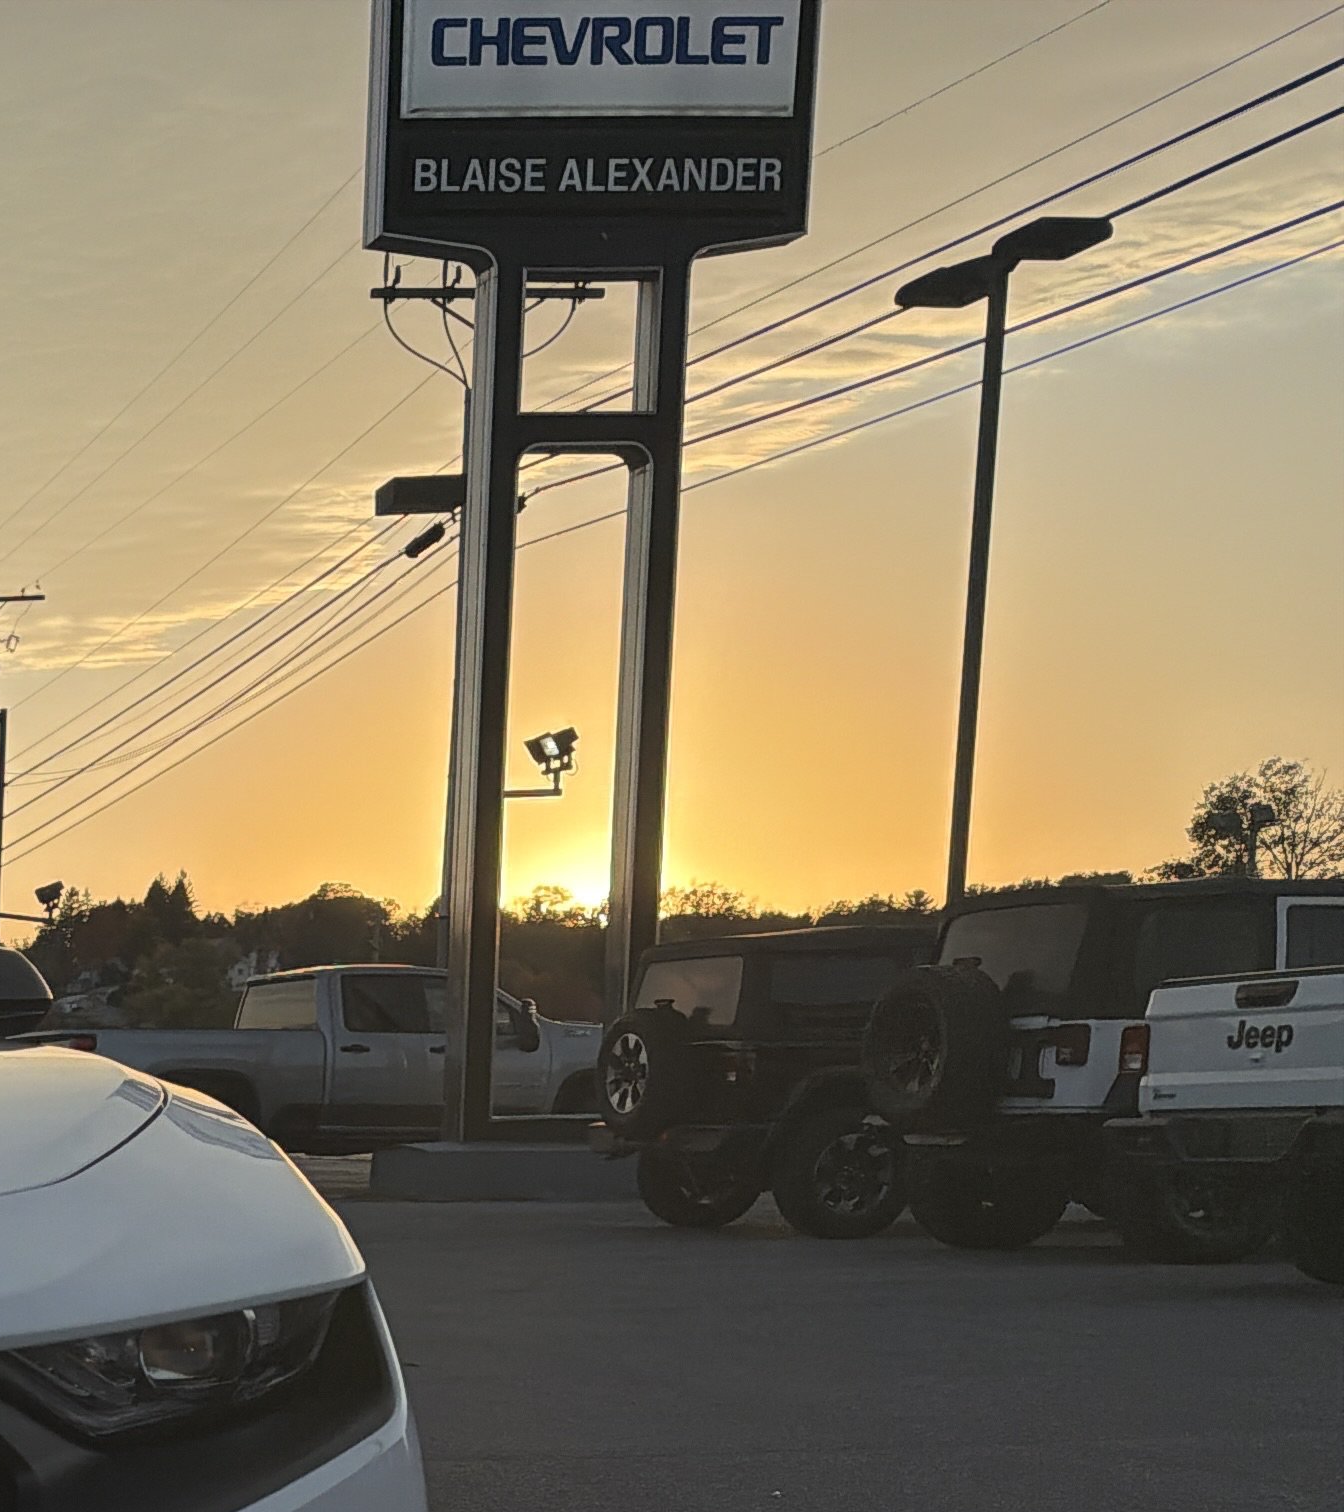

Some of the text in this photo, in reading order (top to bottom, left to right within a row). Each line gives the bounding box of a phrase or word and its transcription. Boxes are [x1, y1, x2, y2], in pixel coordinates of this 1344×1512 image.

[431, 16, 785, 66] CHEVROLET
[413, 157, 783, 192] BLAISE ALEXANDER
[1227, 1020, 1294, 1053] Jeep
